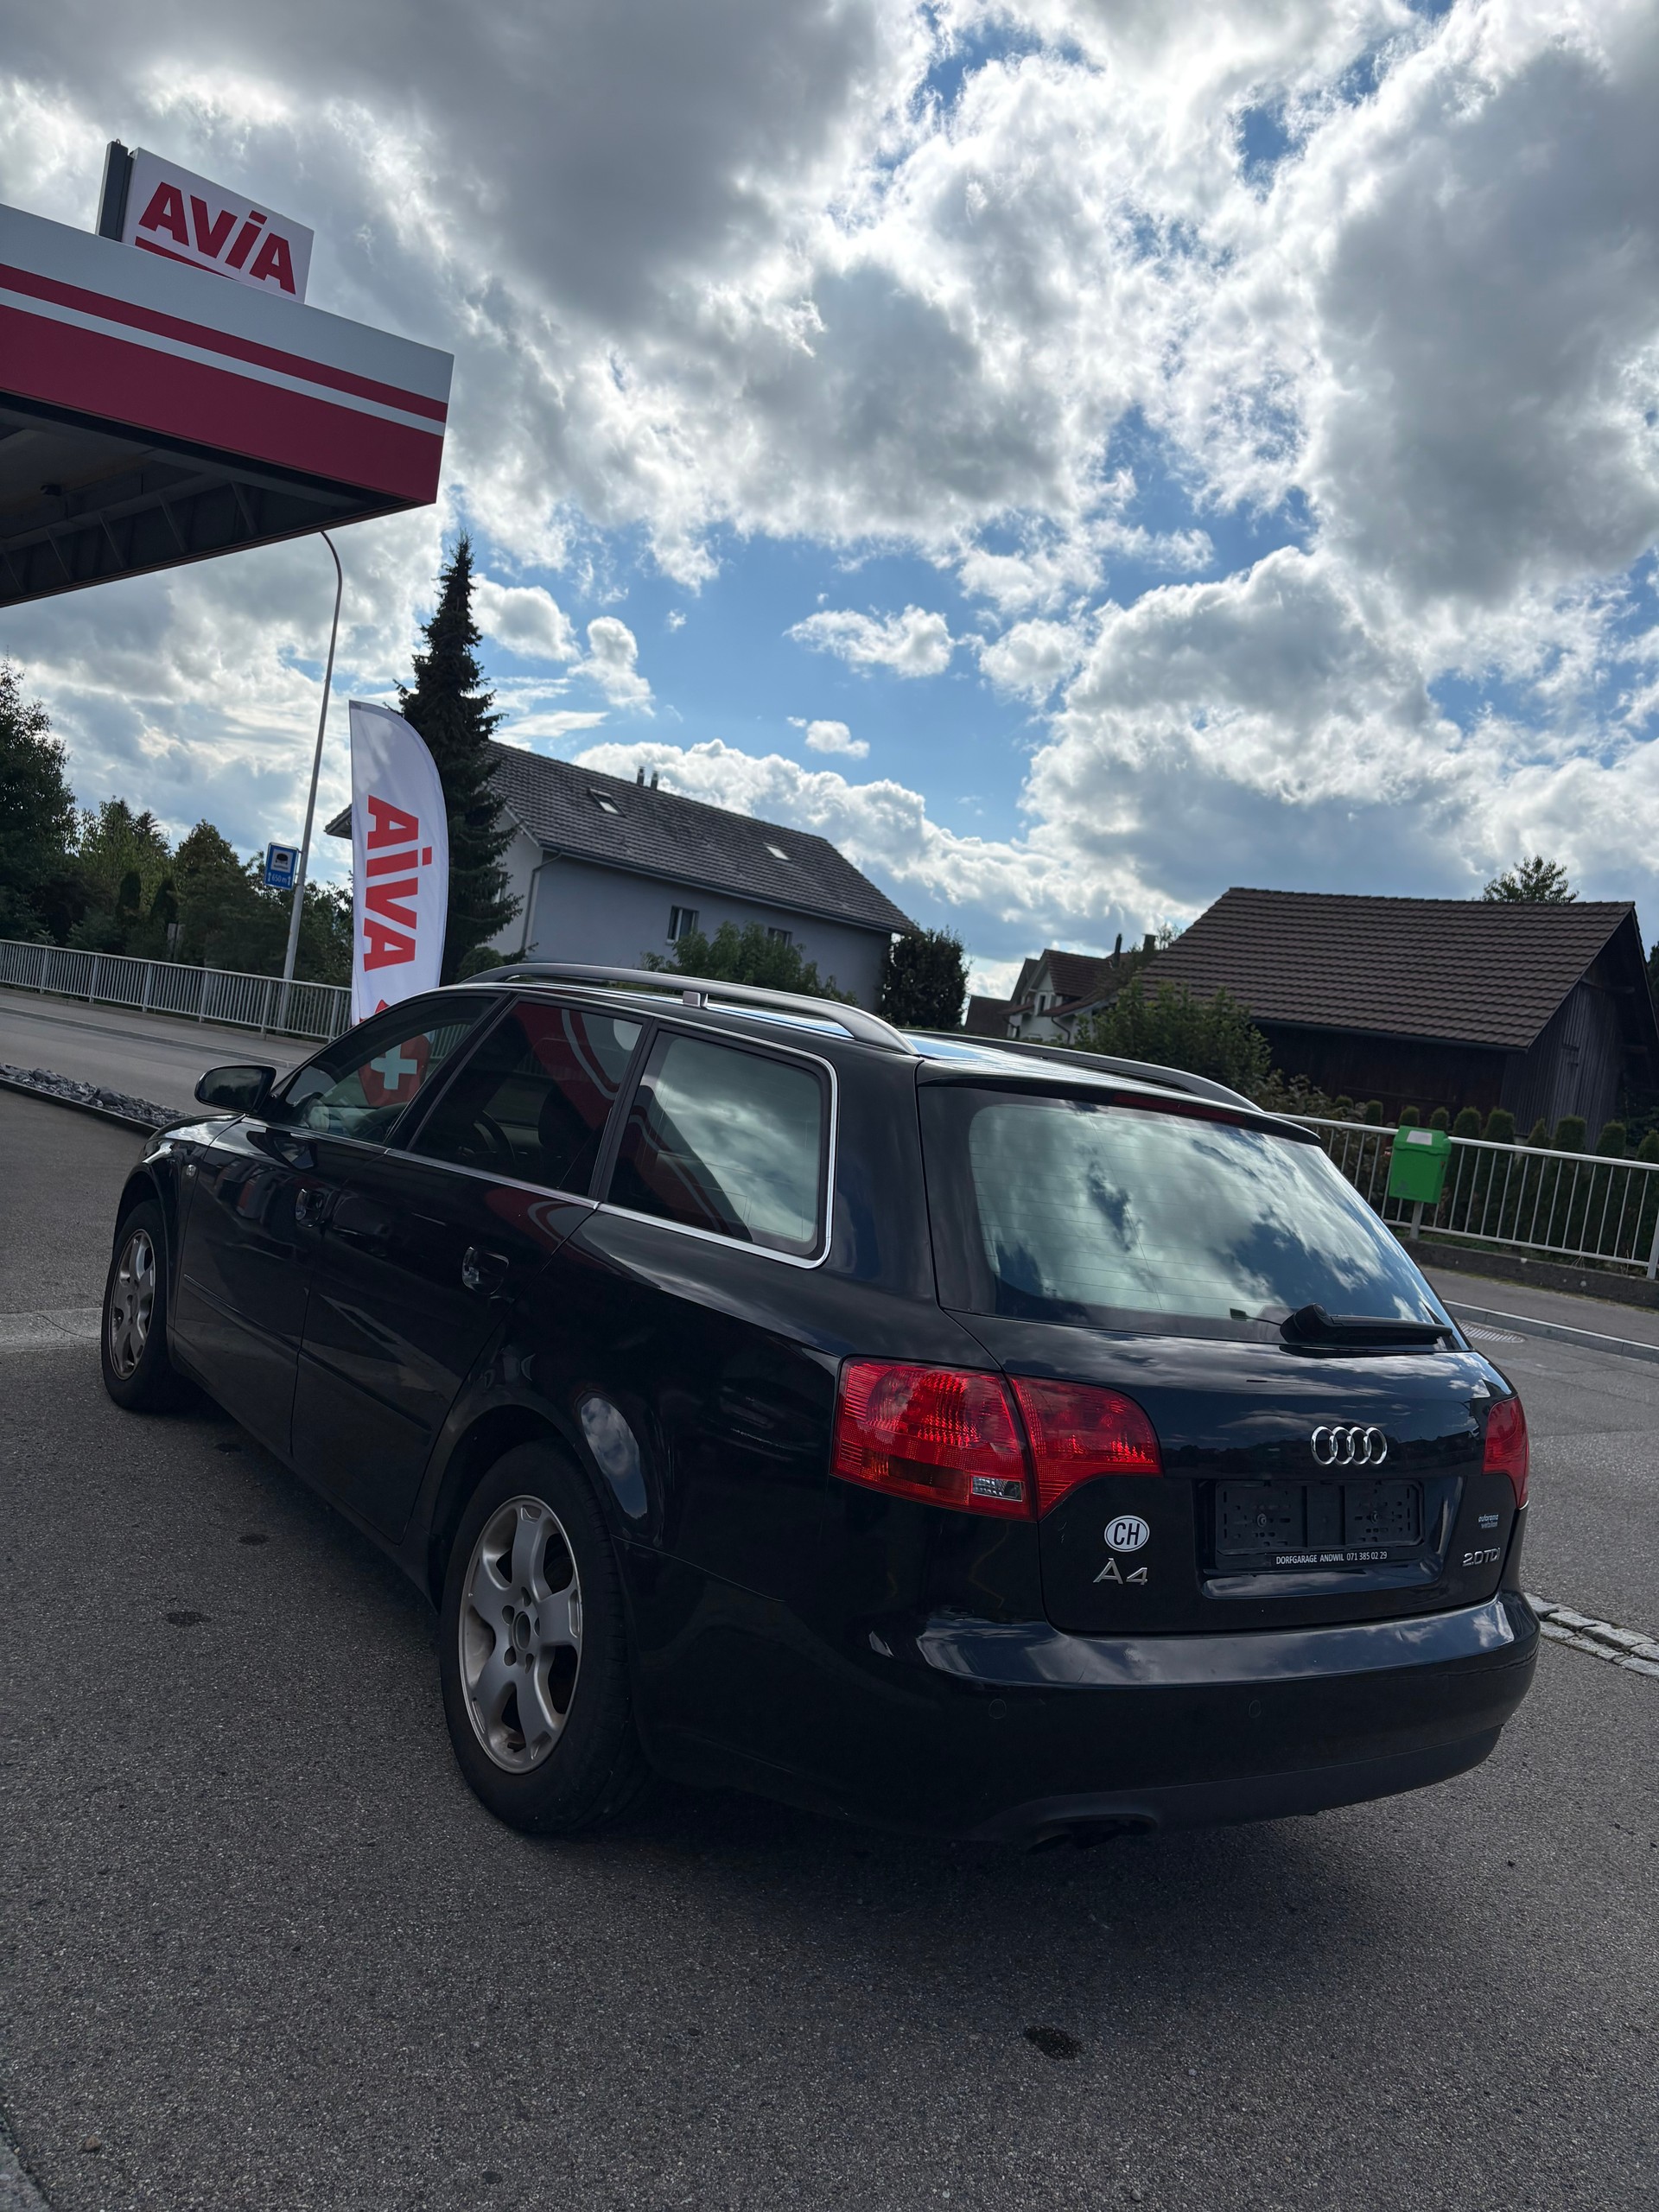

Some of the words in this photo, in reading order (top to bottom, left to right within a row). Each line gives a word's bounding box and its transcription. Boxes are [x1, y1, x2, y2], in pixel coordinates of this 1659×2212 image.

[1114, 1522, 1141, 1546] CH
[1275, 1554, 1318, 1565] DORFGARAGE
[1319, 1554, 1344, 1562] ANDWIL
[1359, 1552, 1370, 1560] 385
[1380, 1551, 1388, 1560] 29
[1092, 1558, 1148, 1586] A4
